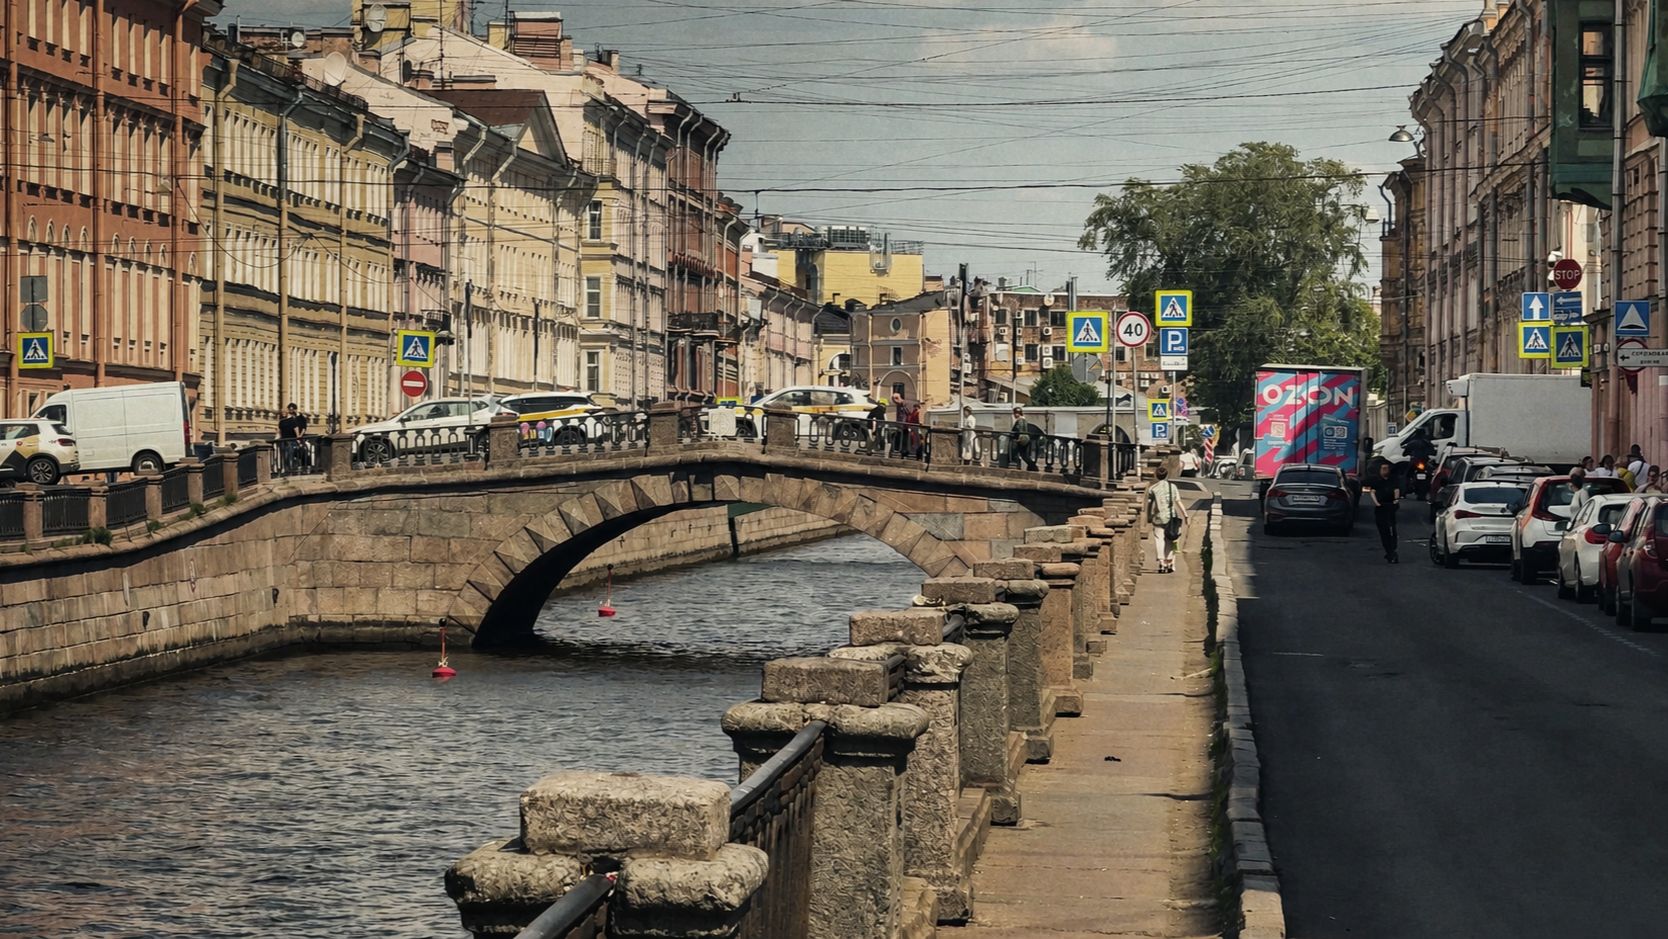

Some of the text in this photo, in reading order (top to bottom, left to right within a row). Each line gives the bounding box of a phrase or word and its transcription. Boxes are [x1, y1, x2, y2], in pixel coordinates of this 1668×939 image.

[1555, 269, 1581, 280] STOP
[1123, 323, 1143, 337] 40
[1168, 331, 1183, 351] P
[1262, 384, 1354, 406] OZON
[1156, 425, 1165, 437] P
